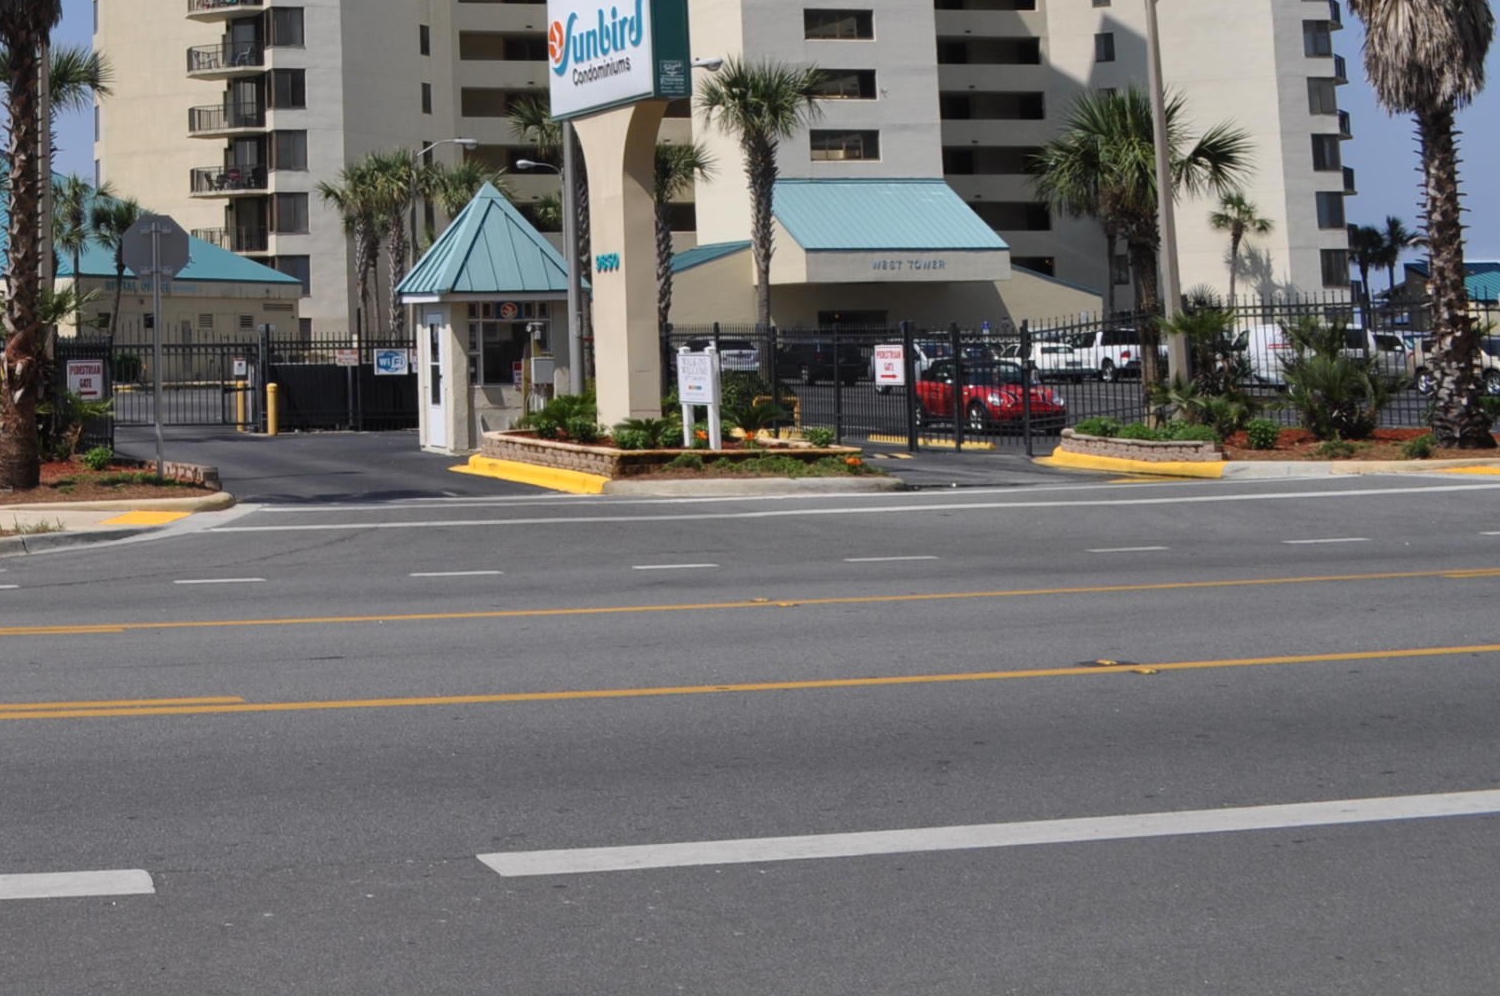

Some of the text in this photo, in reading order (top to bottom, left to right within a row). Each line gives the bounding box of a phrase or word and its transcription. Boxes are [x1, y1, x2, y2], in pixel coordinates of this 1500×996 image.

[573, 57, 631, 86] Condominiums
[873, 259, 946, 270] WEST TOWER
[69, 365, 101, 375] PEDESTRIAN
[79, 378, 92, 388] GATE
